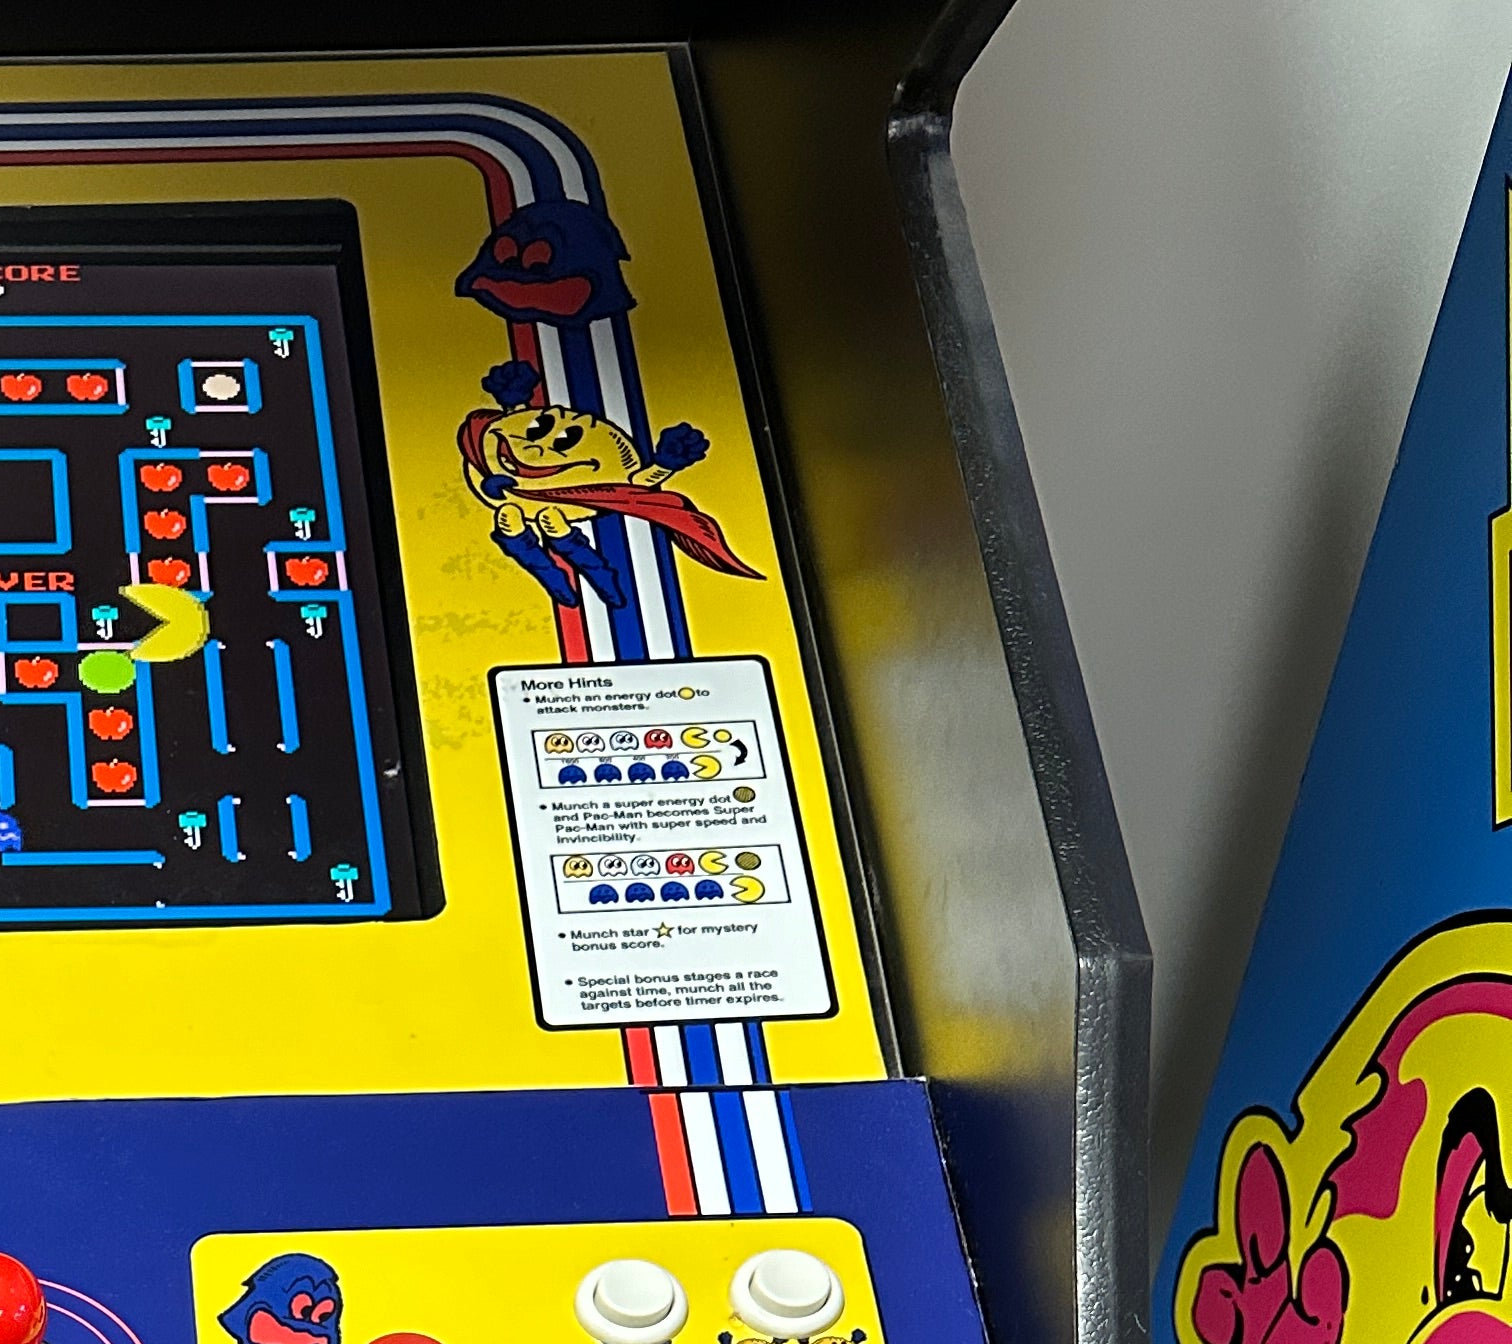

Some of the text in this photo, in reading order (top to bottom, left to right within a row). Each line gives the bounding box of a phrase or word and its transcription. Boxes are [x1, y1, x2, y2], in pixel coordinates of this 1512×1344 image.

[521, 677, 613, 691] More Hints
[535, 688, 710, 704] Munch an energy dot to
[537, 702, 649, 715] attack monsters.
[552, 801, 598, 812] Munch
[615, 800, 653, 811] super
[657, 797, 704, 808] energy
[709, 794, 731, 804] dot
[553, 805, 755, 822] and Pac-Man becomes Super
[555, 815, 767, 833] Pac-Man with super speed and
[571, 923, 758, 940] Munch star for mystery
[572, 940, 665, 952] bonus score.
[578, 969, 778, 988] Special bonus stages a race
[580, 981, 772, 1000] against time, munch all the
[581, 993, 785, 1013] targets before timer expires.
